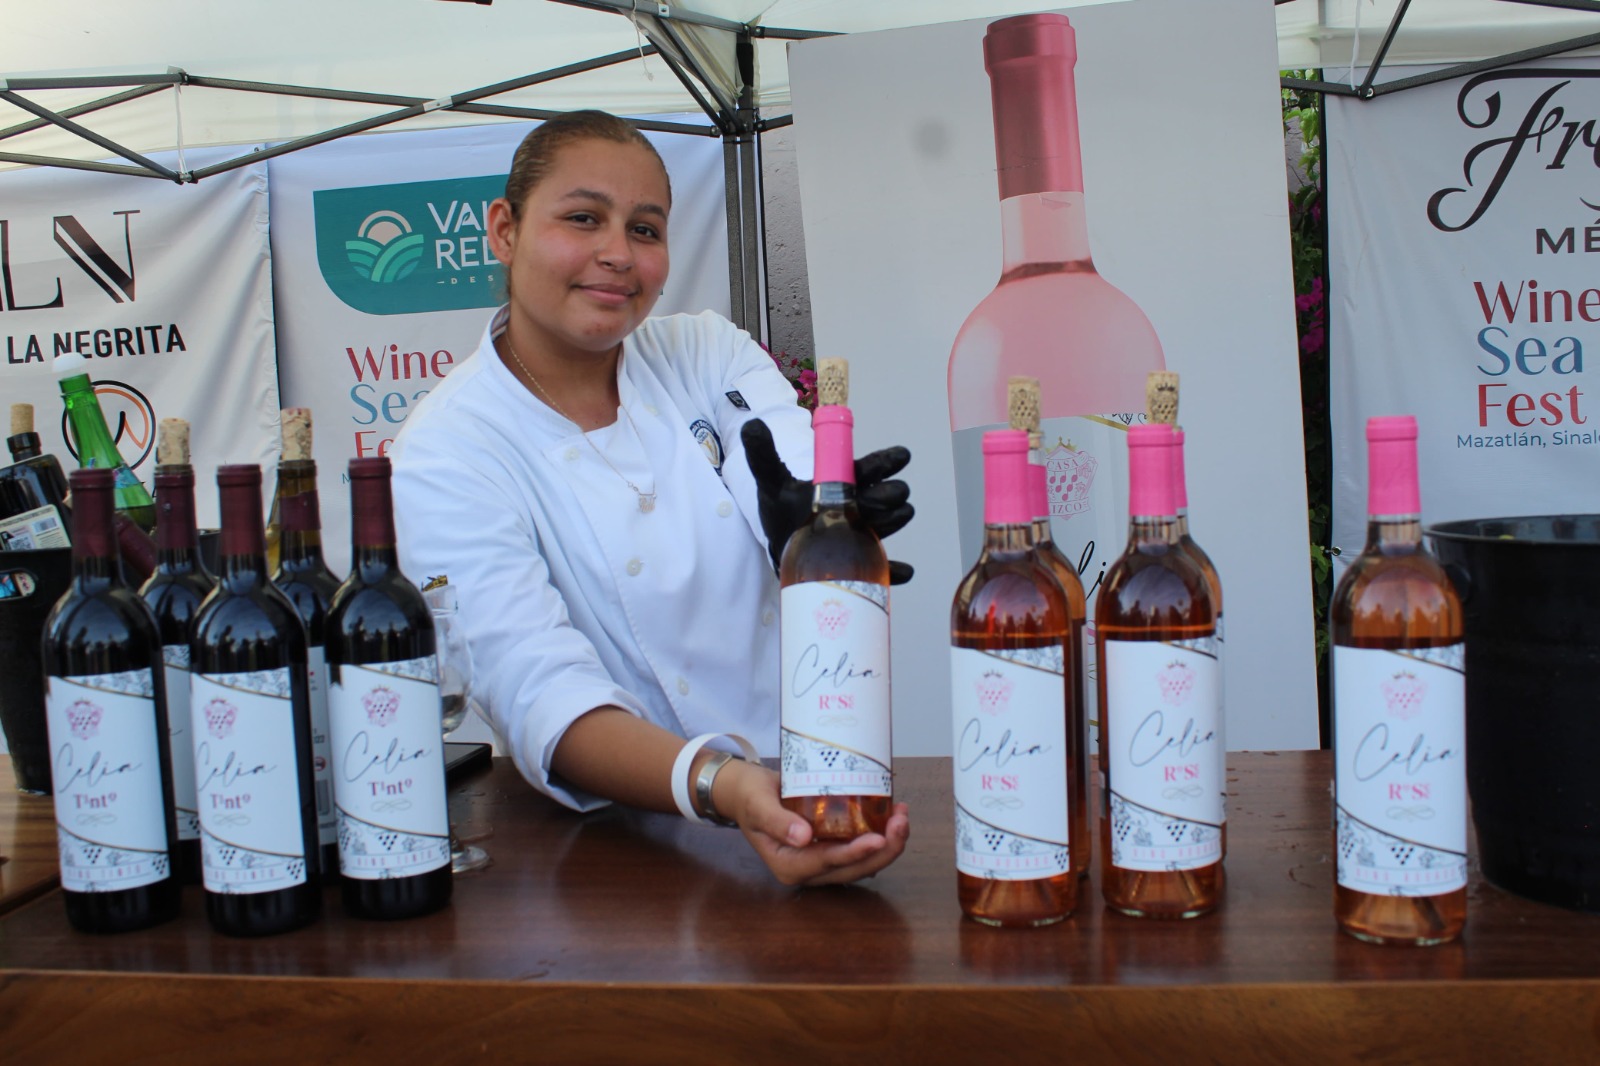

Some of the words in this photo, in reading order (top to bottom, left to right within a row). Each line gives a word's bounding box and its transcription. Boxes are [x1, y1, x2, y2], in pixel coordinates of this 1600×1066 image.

[1473, 279, 1600, 324] Wine
[7, 334, 45, 364] LA
[53, 323, 187, 360] NEGRITA
[345, 344, 454, 382] Wine
[1477, 326, 1583, 376] Sea
[350, 383, 431, 425] Se
[1478, 383, 1588, 427] Fest
[1457, 432, 1547, 448] Mazatlán,
[1552, 429, 1600, 446] Sinal
[1047, 459, 1079, 470] CASA
